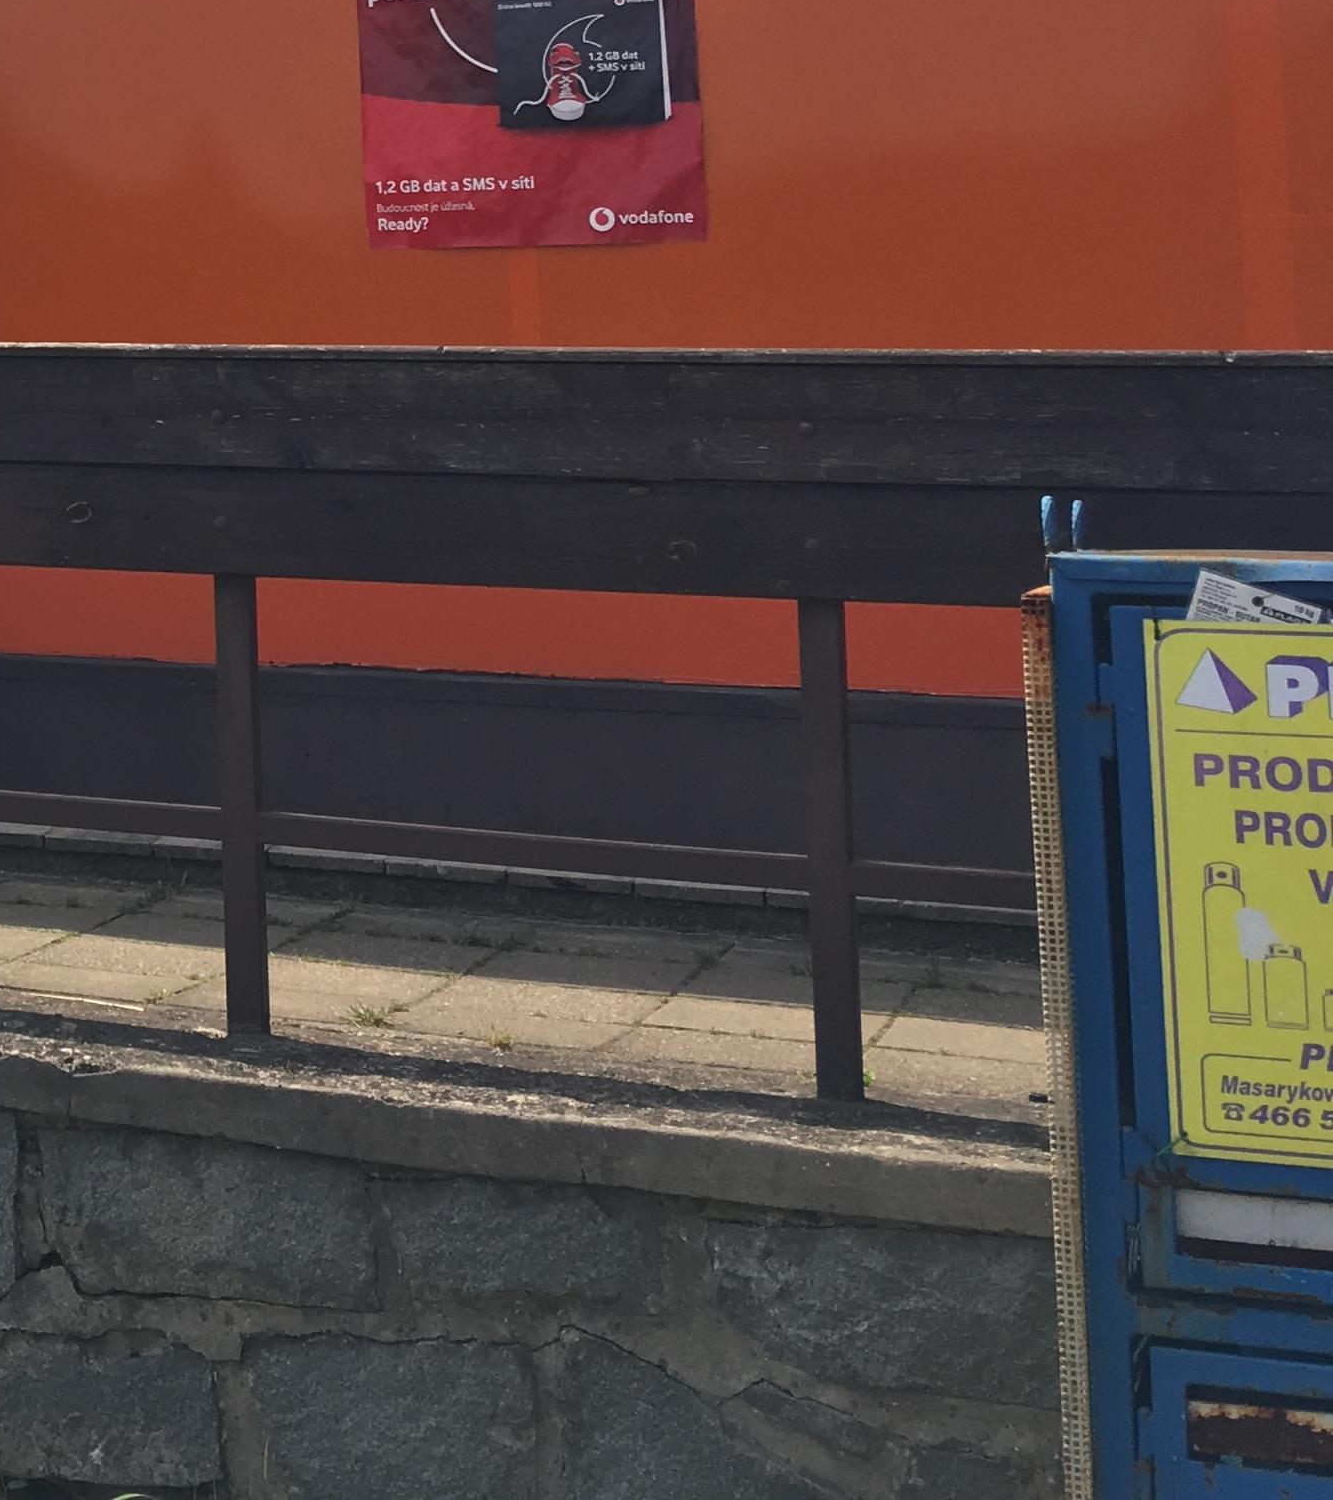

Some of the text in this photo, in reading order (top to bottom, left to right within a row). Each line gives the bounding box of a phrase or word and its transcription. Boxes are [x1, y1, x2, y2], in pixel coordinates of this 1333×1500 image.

[604, 51, 620, 60] GB
[621, 51, 639, 60] dat
[596, 62, 620, 72] SMS
[375, 174, 535, 195] 1,2 GB dat a SMS v síti
[376, 203, 429, 213] Budoucnost
[430, 203, 439, 214] je
[618, 209, 694, 225] vodafone
[377, 216, 429, 233] Ready?
[1265, 655, 1333, 719] P
[1234, 809, 1333, 848] PRO
[1299, 1043, 1333, 1072] P
[1248, 1104, 1312, 1128] 466
